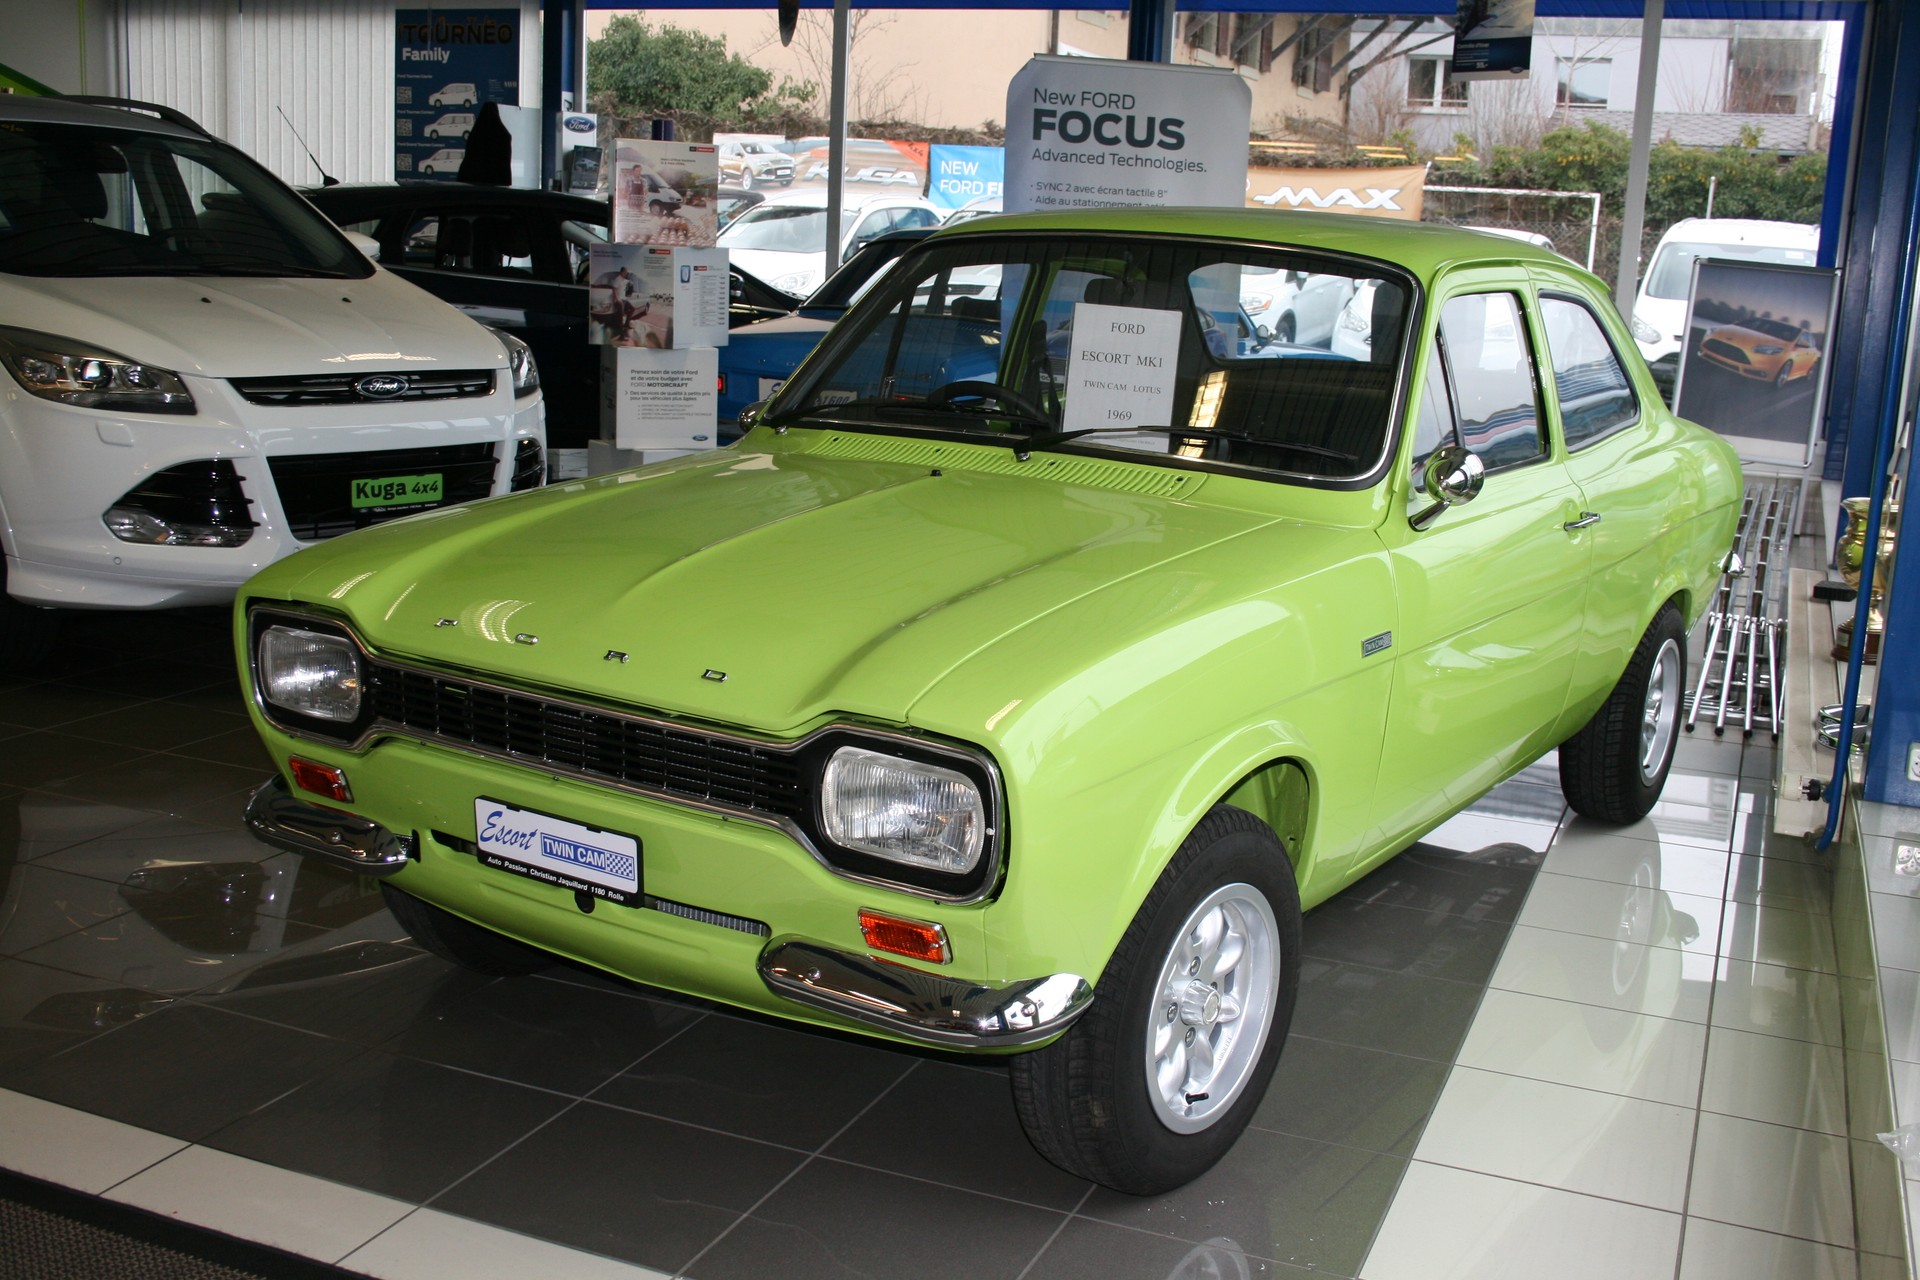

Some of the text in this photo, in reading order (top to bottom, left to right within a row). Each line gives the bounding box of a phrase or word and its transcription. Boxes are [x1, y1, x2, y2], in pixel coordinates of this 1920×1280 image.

[402, 24, 513, 45] TOURNEO
[402, 48, 450, 63] Family
[1034, 88, 1135, 110] New FORD
[1032, 108, 1186, 150] FOCUS
[940, 160, 980, 176] NEW
[1032, 148, 1208, 173] Advanced Technologies.
[940, 180, 984, 196] FORD
[1036, 182, 1063, 192] SYNC
[1066, 184, 1072, 192] 2
[1074, 185, 1095, 194] avec
[1097, 185, 1124, 196] écran
[1126, 188, 1155, 198] tactile
[1034, 196, 1057, 206] Aide
[1058, 198, 1071, 206] au
[1111, 322, 1145, 334] FORD
[1082, 350, 1130, 364] ESCORT
[369, 378, 399, 392] Ford
[1084, 380, 1161, 394] TWIN CAM LOTUS
[1107, 410, 1132, 420] 1969
[356, 480, 438, 500] Kuga 4x4
[480, 810, 606, 868] Escort TWIN CAM
[488, 856, 624, 902] Auto Passion Christian Jaquillard 1180 Rolle
